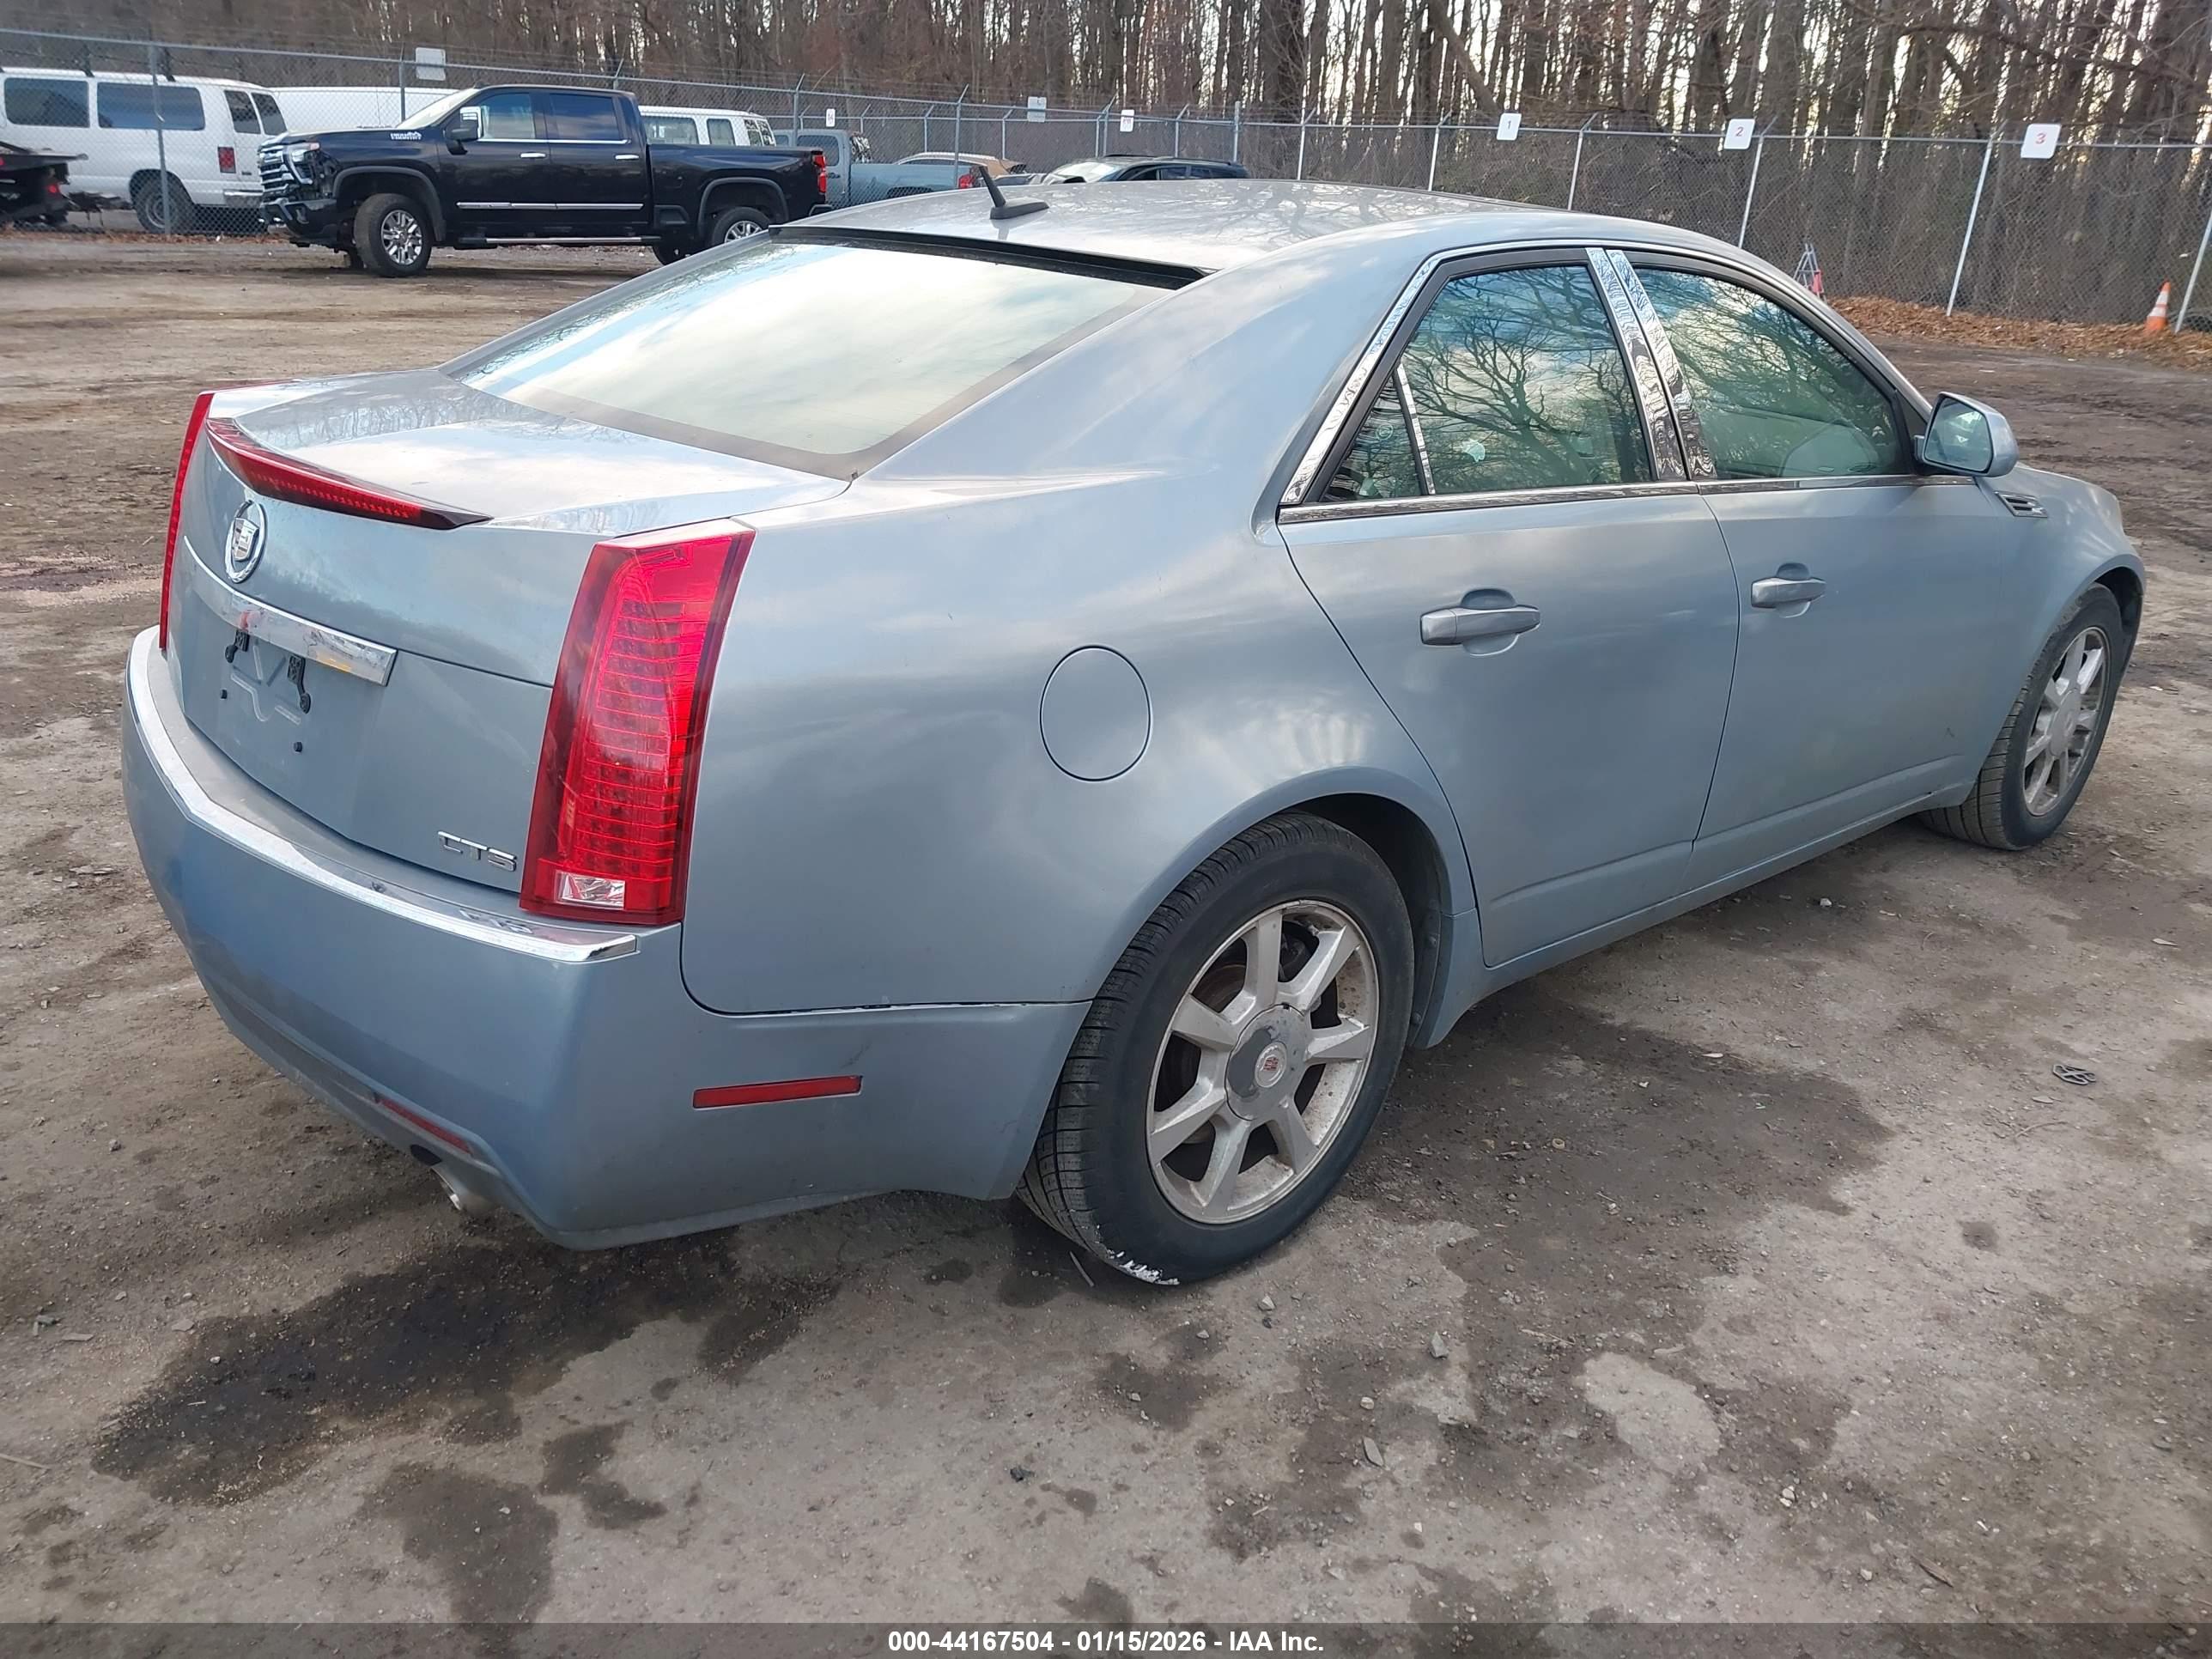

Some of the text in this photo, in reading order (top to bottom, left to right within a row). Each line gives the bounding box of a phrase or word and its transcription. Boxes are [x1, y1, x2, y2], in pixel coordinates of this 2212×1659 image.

[1735, 126, 1744, 137] 2
[2035, 133, 2046, 145] 3
[438, 830, 518, 872] CTS
